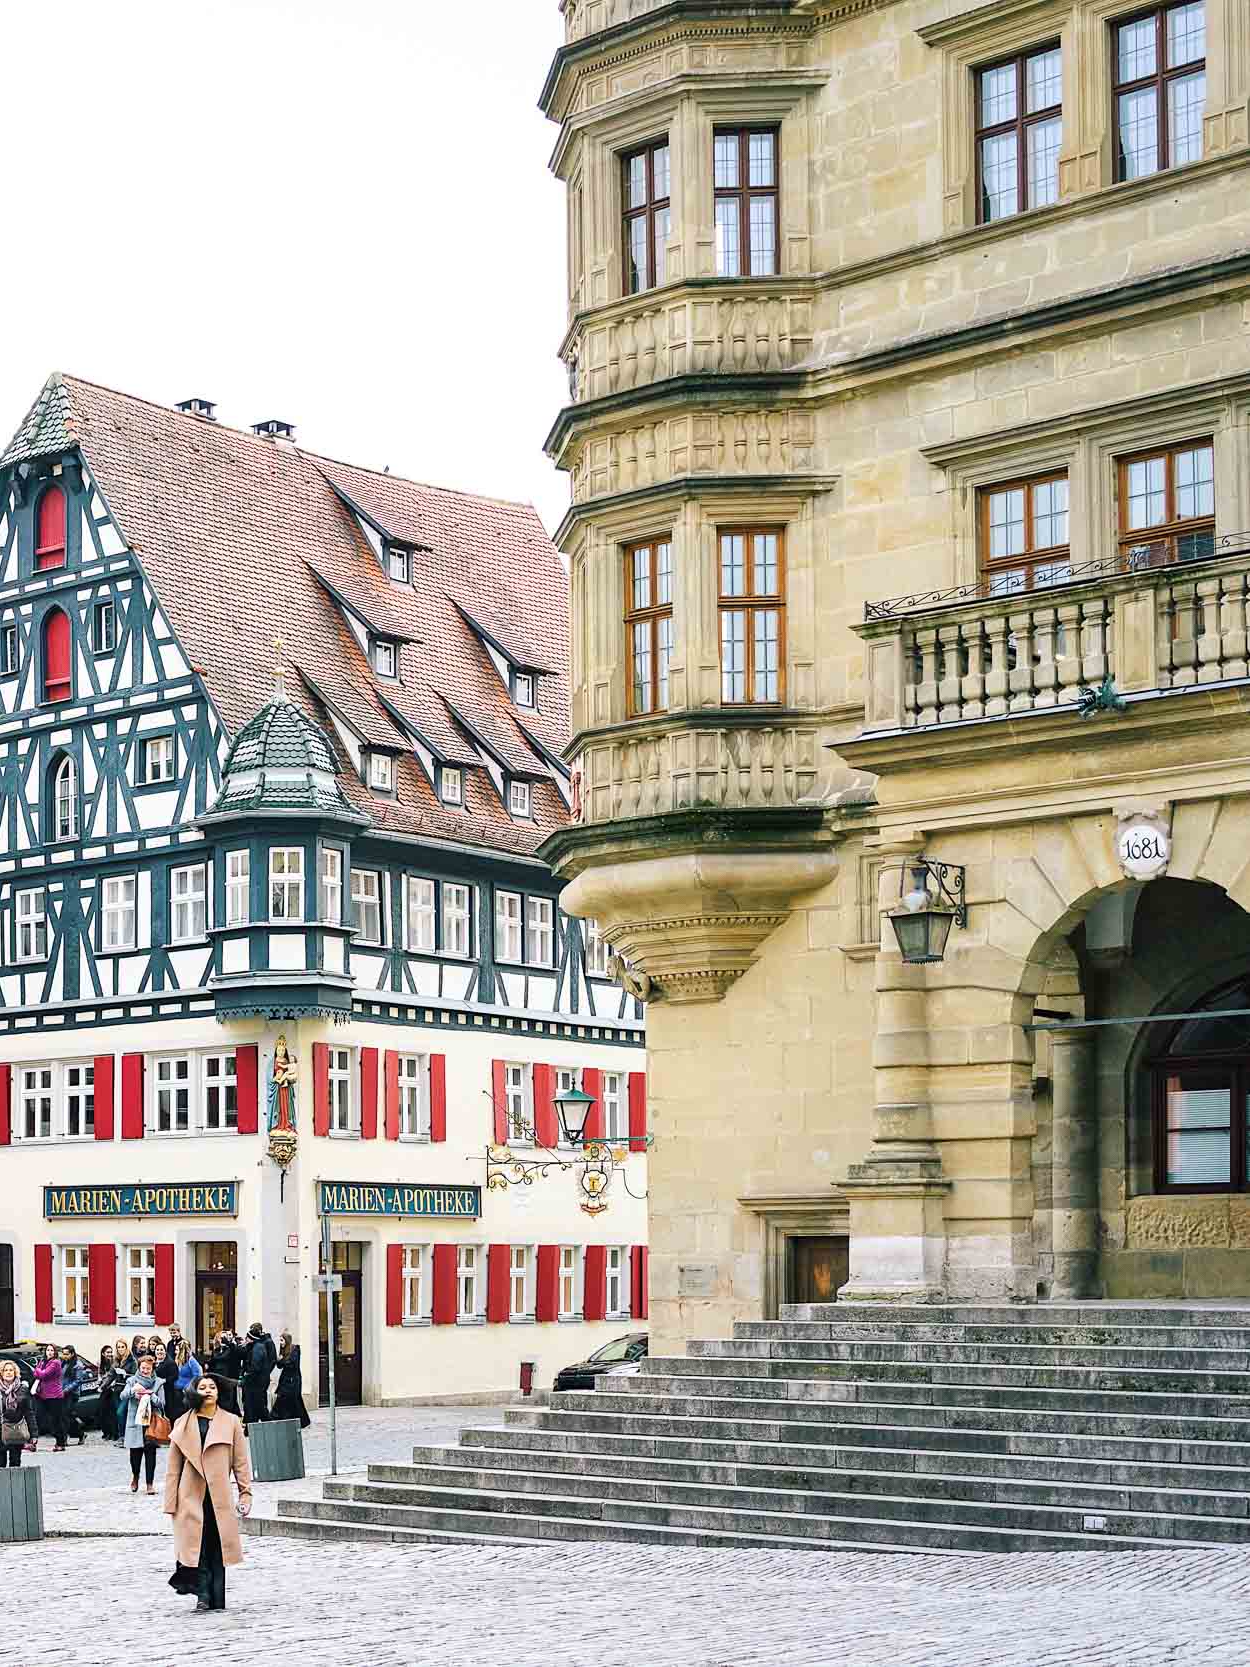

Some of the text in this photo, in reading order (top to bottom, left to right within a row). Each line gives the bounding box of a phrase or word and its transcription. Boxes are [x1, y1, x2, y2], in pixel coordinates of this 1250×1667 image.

[1124, 836, 1165, 860] 1681
[50, 1187, 230, 1214] MARIEN-APOTHEKE
[323, 1186, 475, 1214] MARIEN-APOTHEKE
